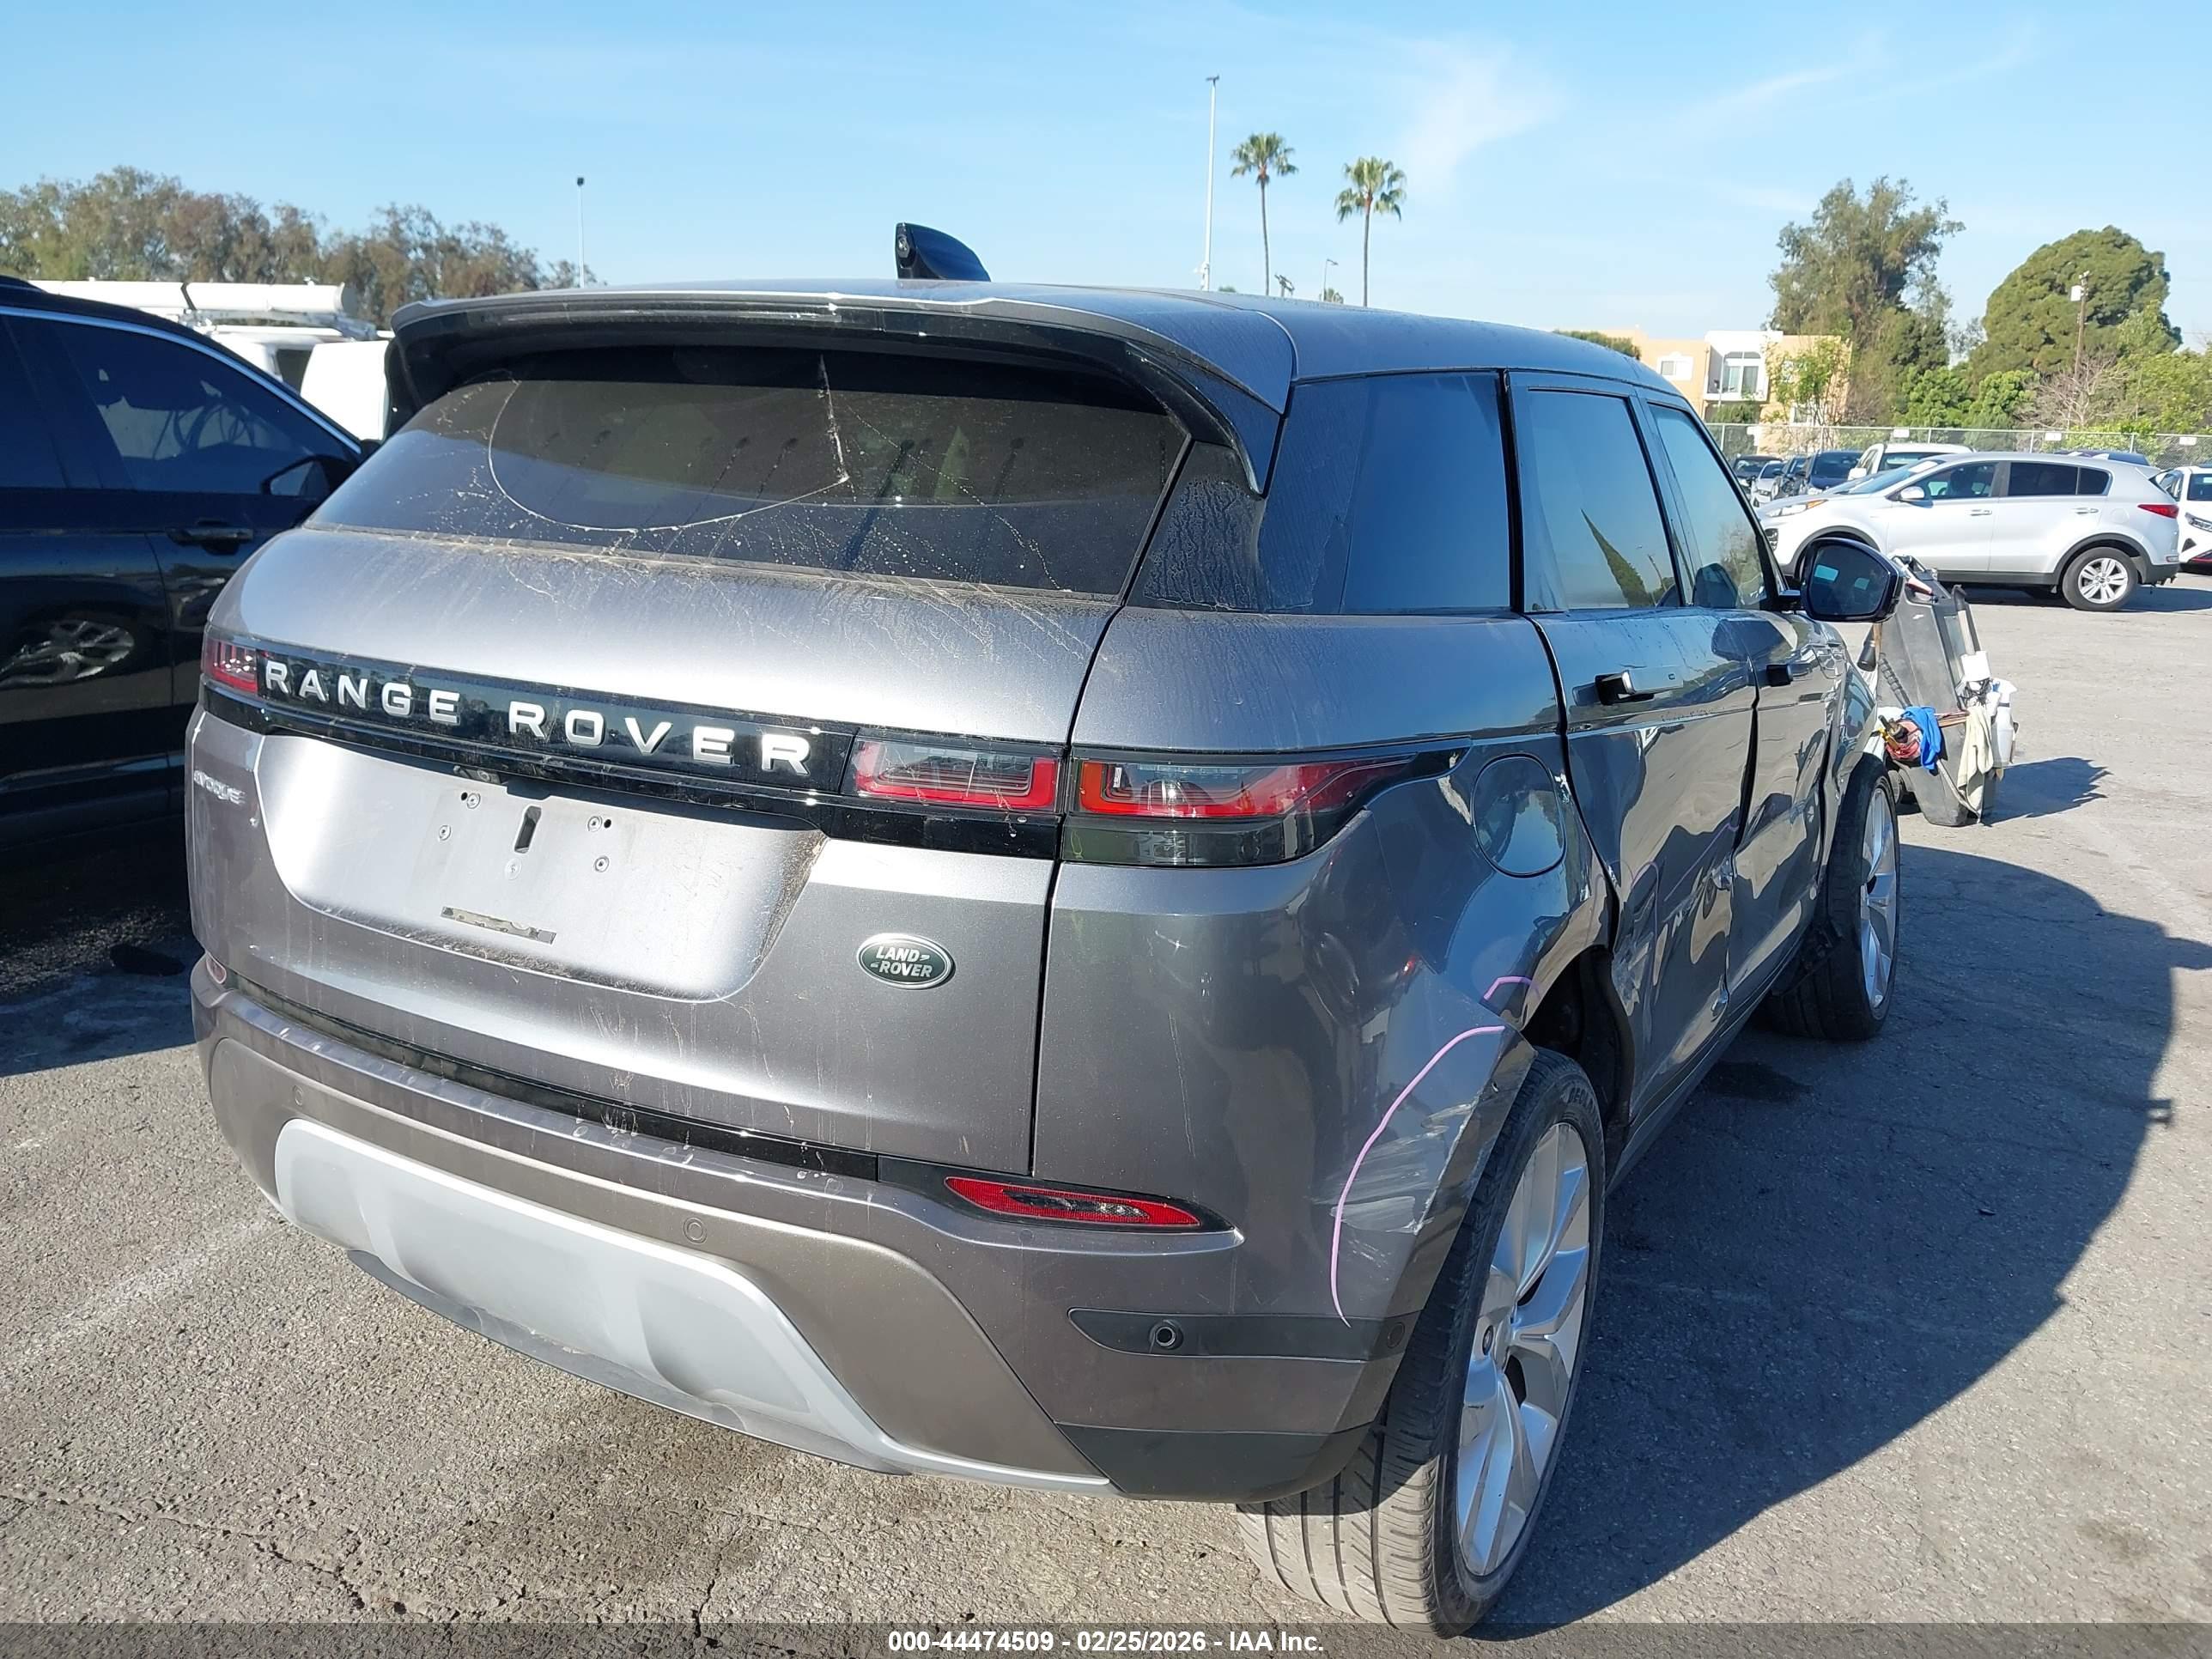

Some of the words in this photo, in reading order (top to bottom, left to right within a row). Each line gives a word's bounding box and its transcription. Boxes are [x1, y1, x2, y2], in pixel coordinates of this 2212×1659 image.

[264, 659, 461, 726] RANGE
[507, 700, 812, 775] ROVER
[876, 945, 921, 963] LAND
[878, 960, 933, 978] ROVER
